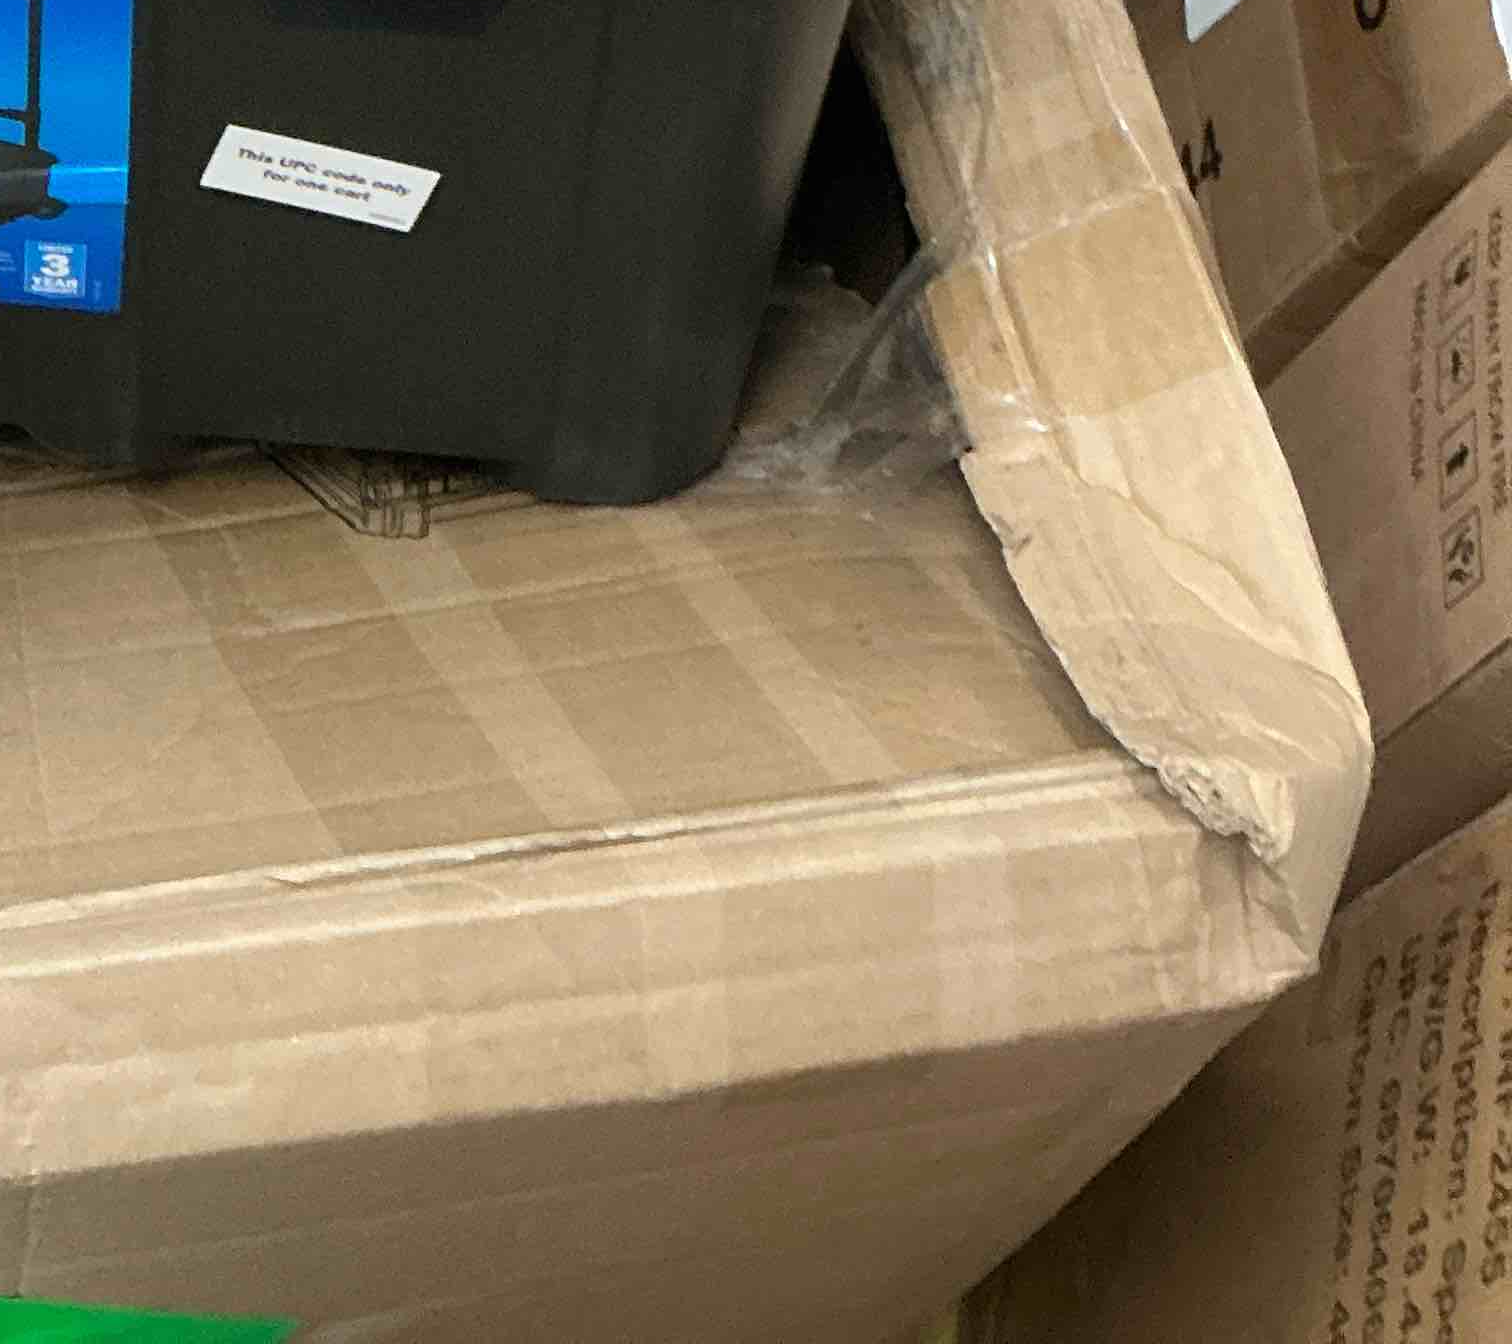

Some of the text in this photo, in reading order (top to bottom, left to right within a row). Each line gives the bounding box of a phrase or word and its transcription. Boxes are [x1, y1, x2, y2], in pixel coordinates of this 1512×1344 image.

[238, 148, 410, 196] This UPC code only
[263, 169, 371, 202] for one cart
[39, 253, 70, 277] 3
